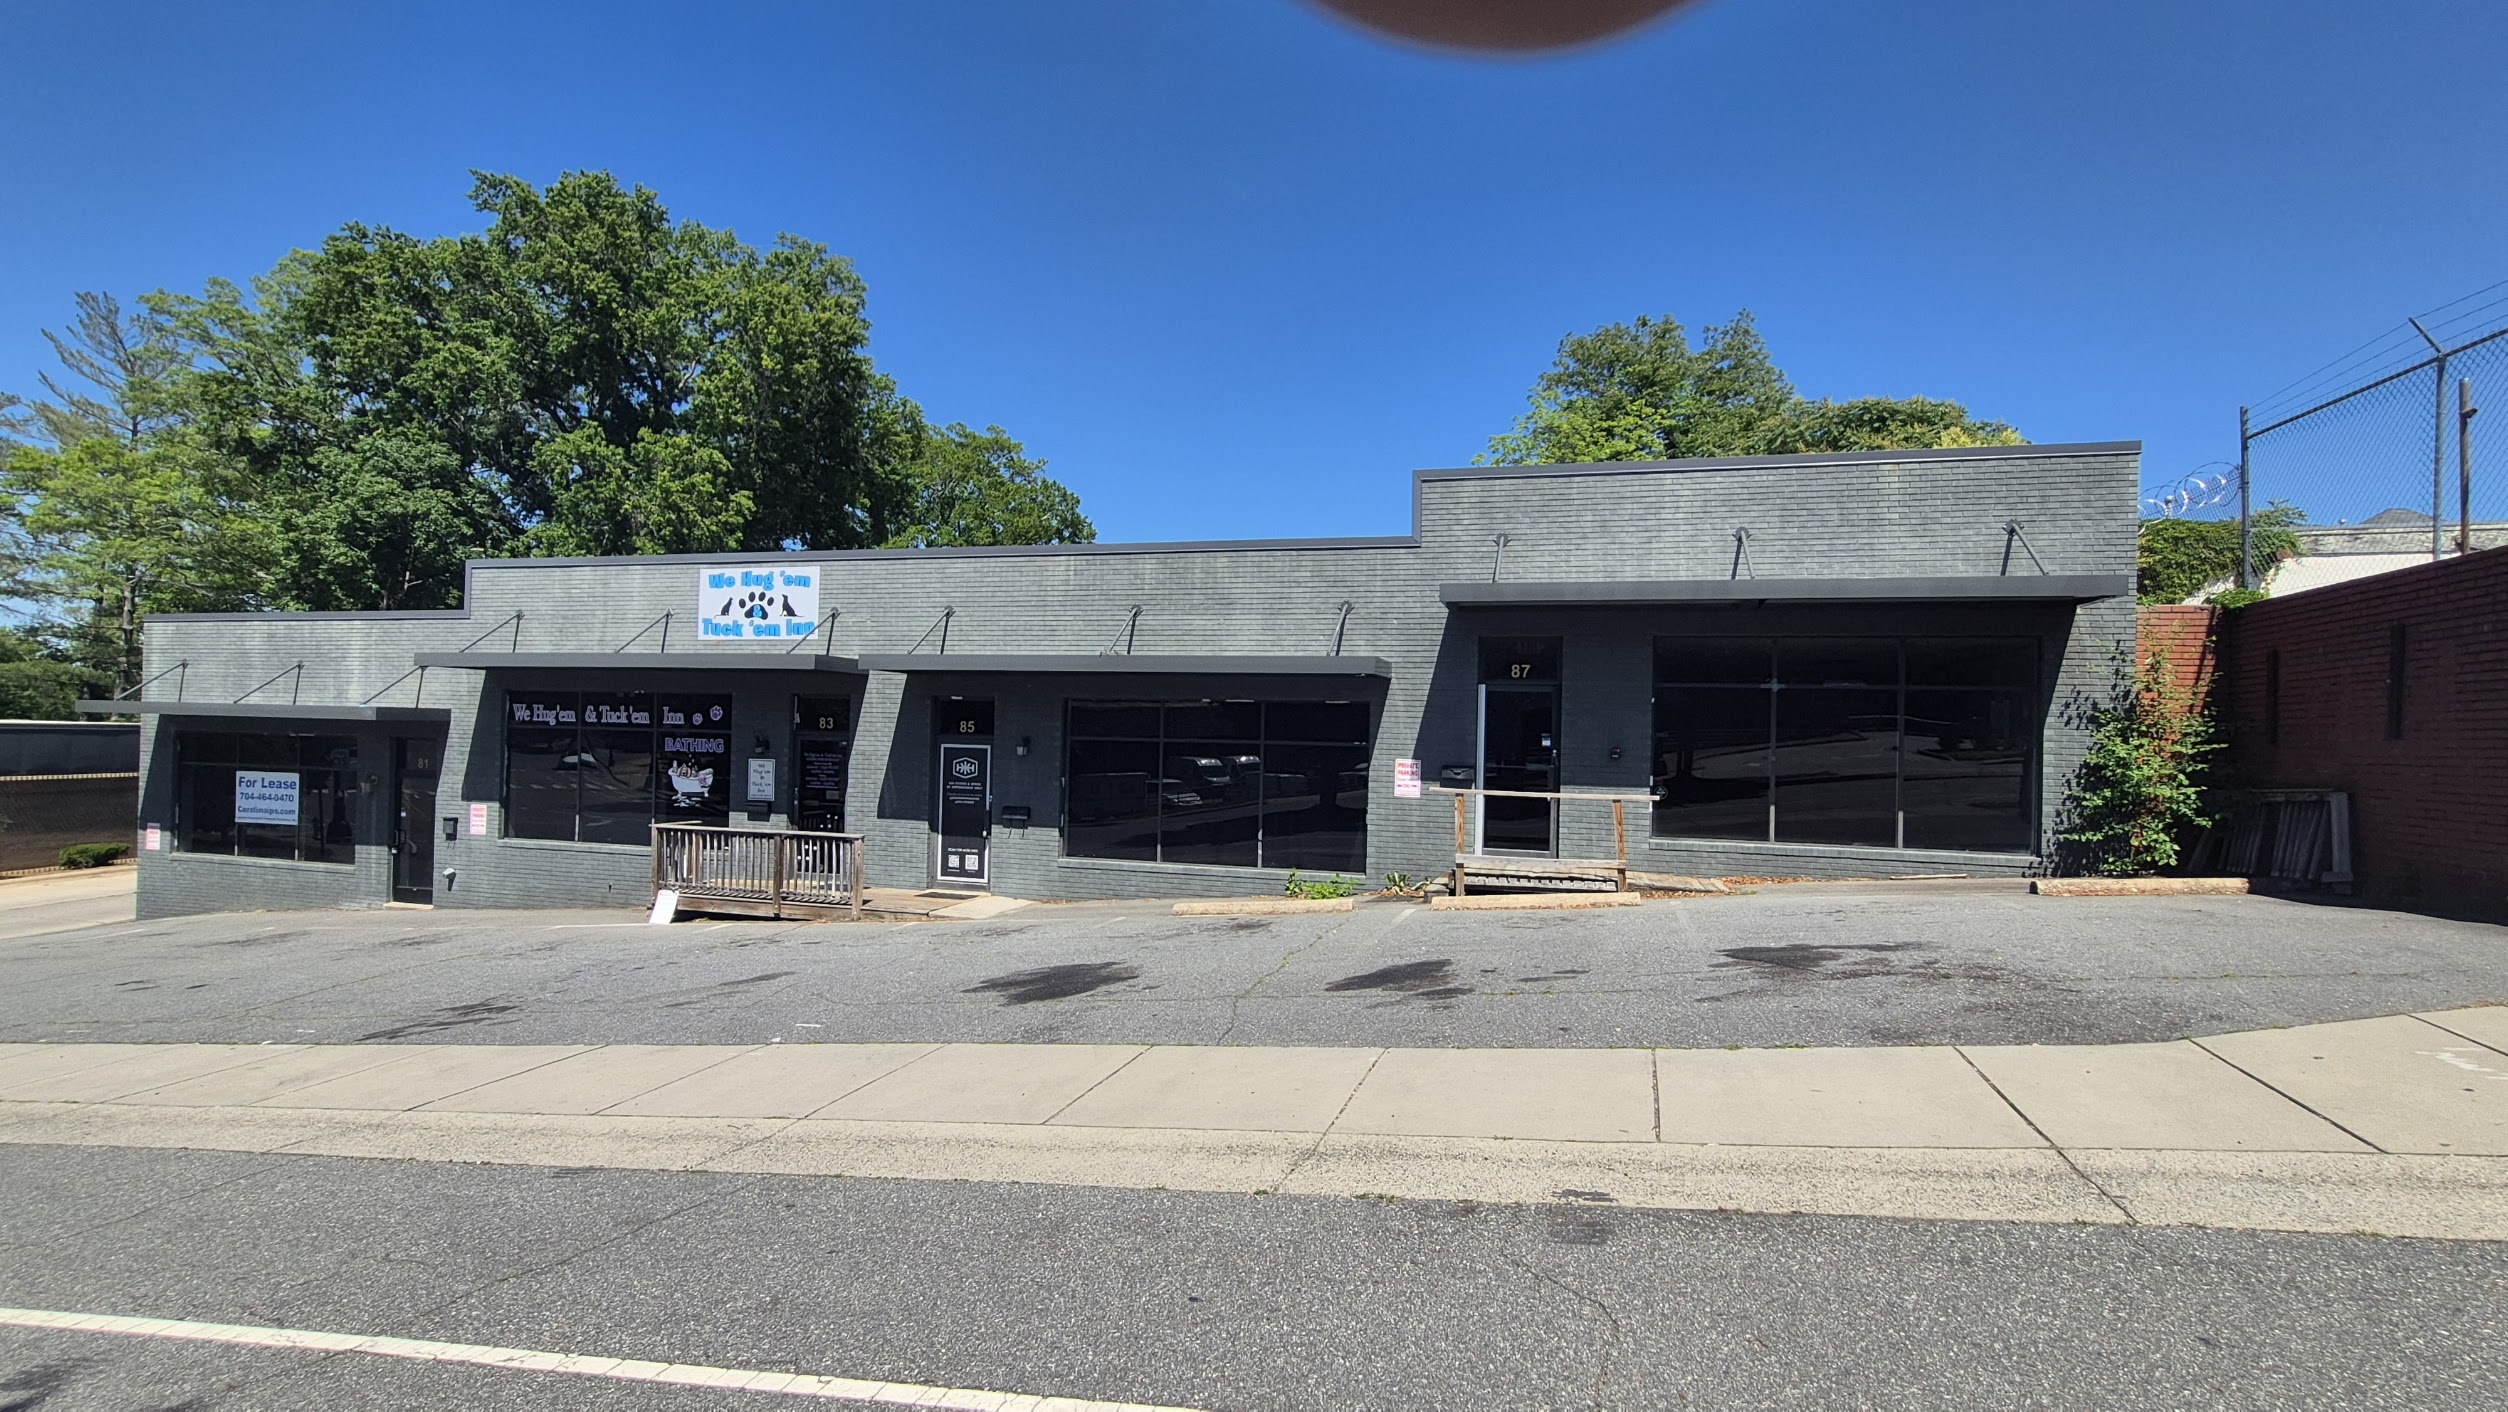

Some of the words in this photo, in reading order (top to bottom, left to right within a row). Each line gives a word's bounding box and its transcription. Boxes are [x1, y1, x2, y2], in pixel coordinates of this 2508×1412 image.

[708, 572, 736, 589] We
[741, 570, 775, 591] Hug
[752, 604, 763, 617] &
[702, 618, 743, 637] Tuck
[786, 618, 816, 636] Inn
[1511, 664, 1531, 678] 87
[513, 703, 531, 721] We
[585, 705, 598, 722] &
[662, 706, 685, 724] Inn
[819, 717, 834, 729] 83
[960, 720, 975, 733] 85
[664, 737, 724, 753] BATHING
[417, 758, 429, 769] 81
[238, 776, 258, 788] For
[261, 777, 297, 790] Lease
[240, 792, 294, 803] 704-464-0470
